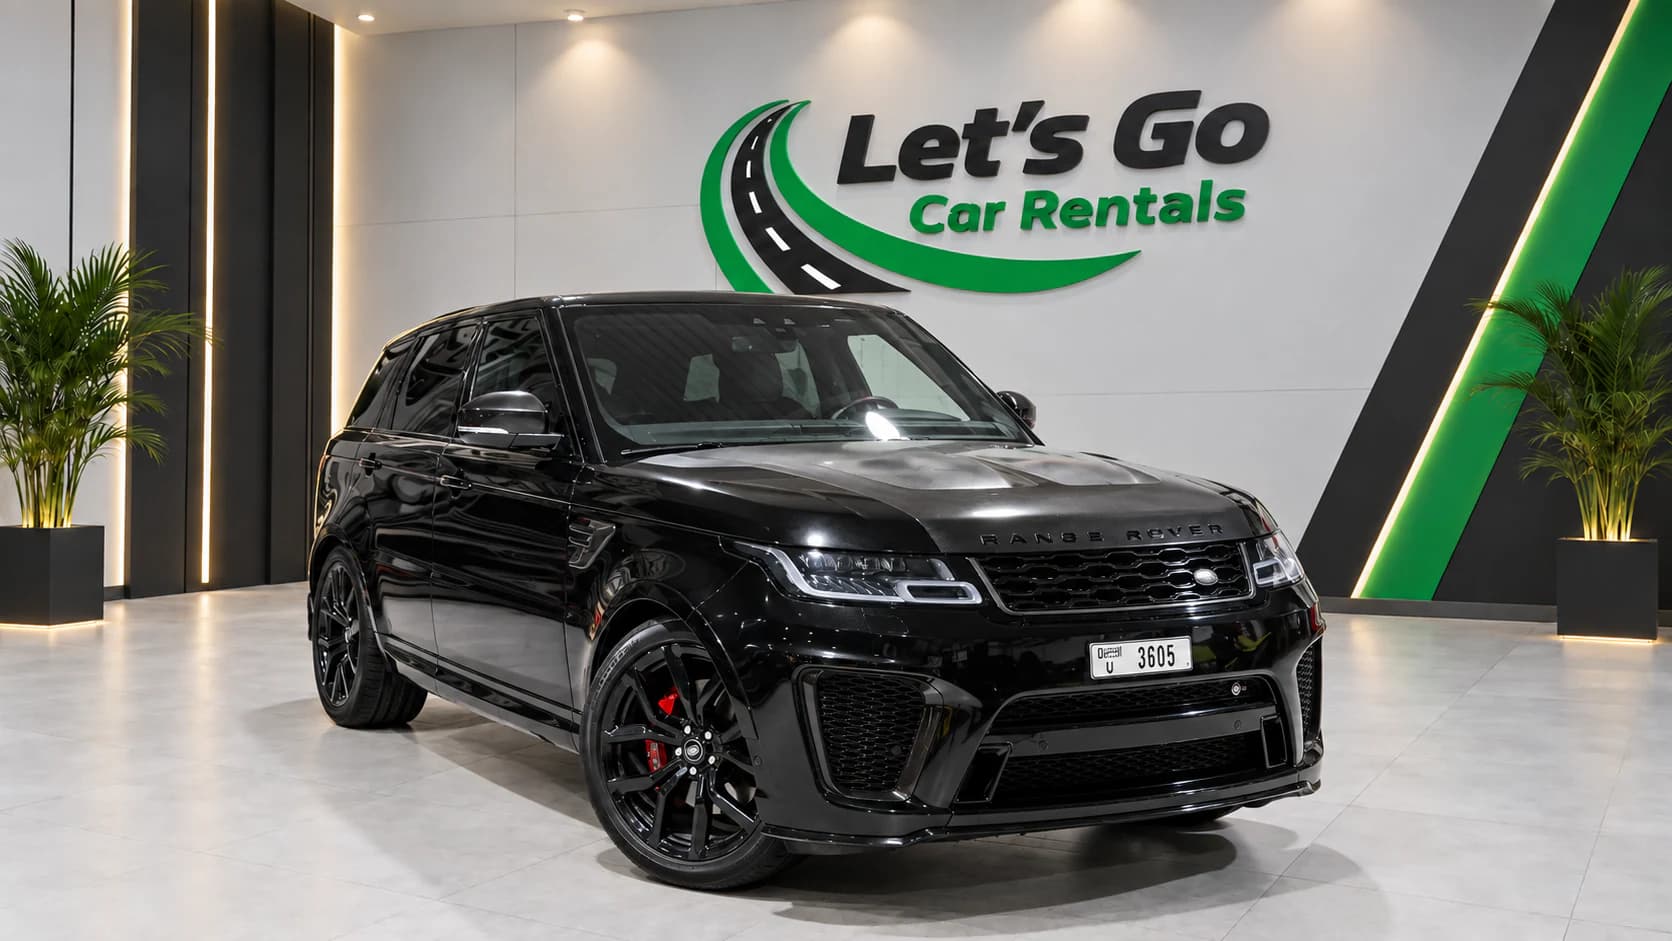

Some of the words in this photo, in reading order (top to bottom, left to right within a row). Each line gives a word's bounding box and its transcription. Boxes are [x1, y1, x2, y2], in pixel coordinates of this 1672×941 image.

[837, 99, 1089, 185] Let's
[1113, 89, 1270, 169] Go
[909, 194, 1006, 234] Car
[1020, 178, 1246, 230] Rentals
[979, 530, 1105, 545] RANGE
[1126, 523, 1224, 542] ROVER
[1137, 644, 1175, 669] 3605
